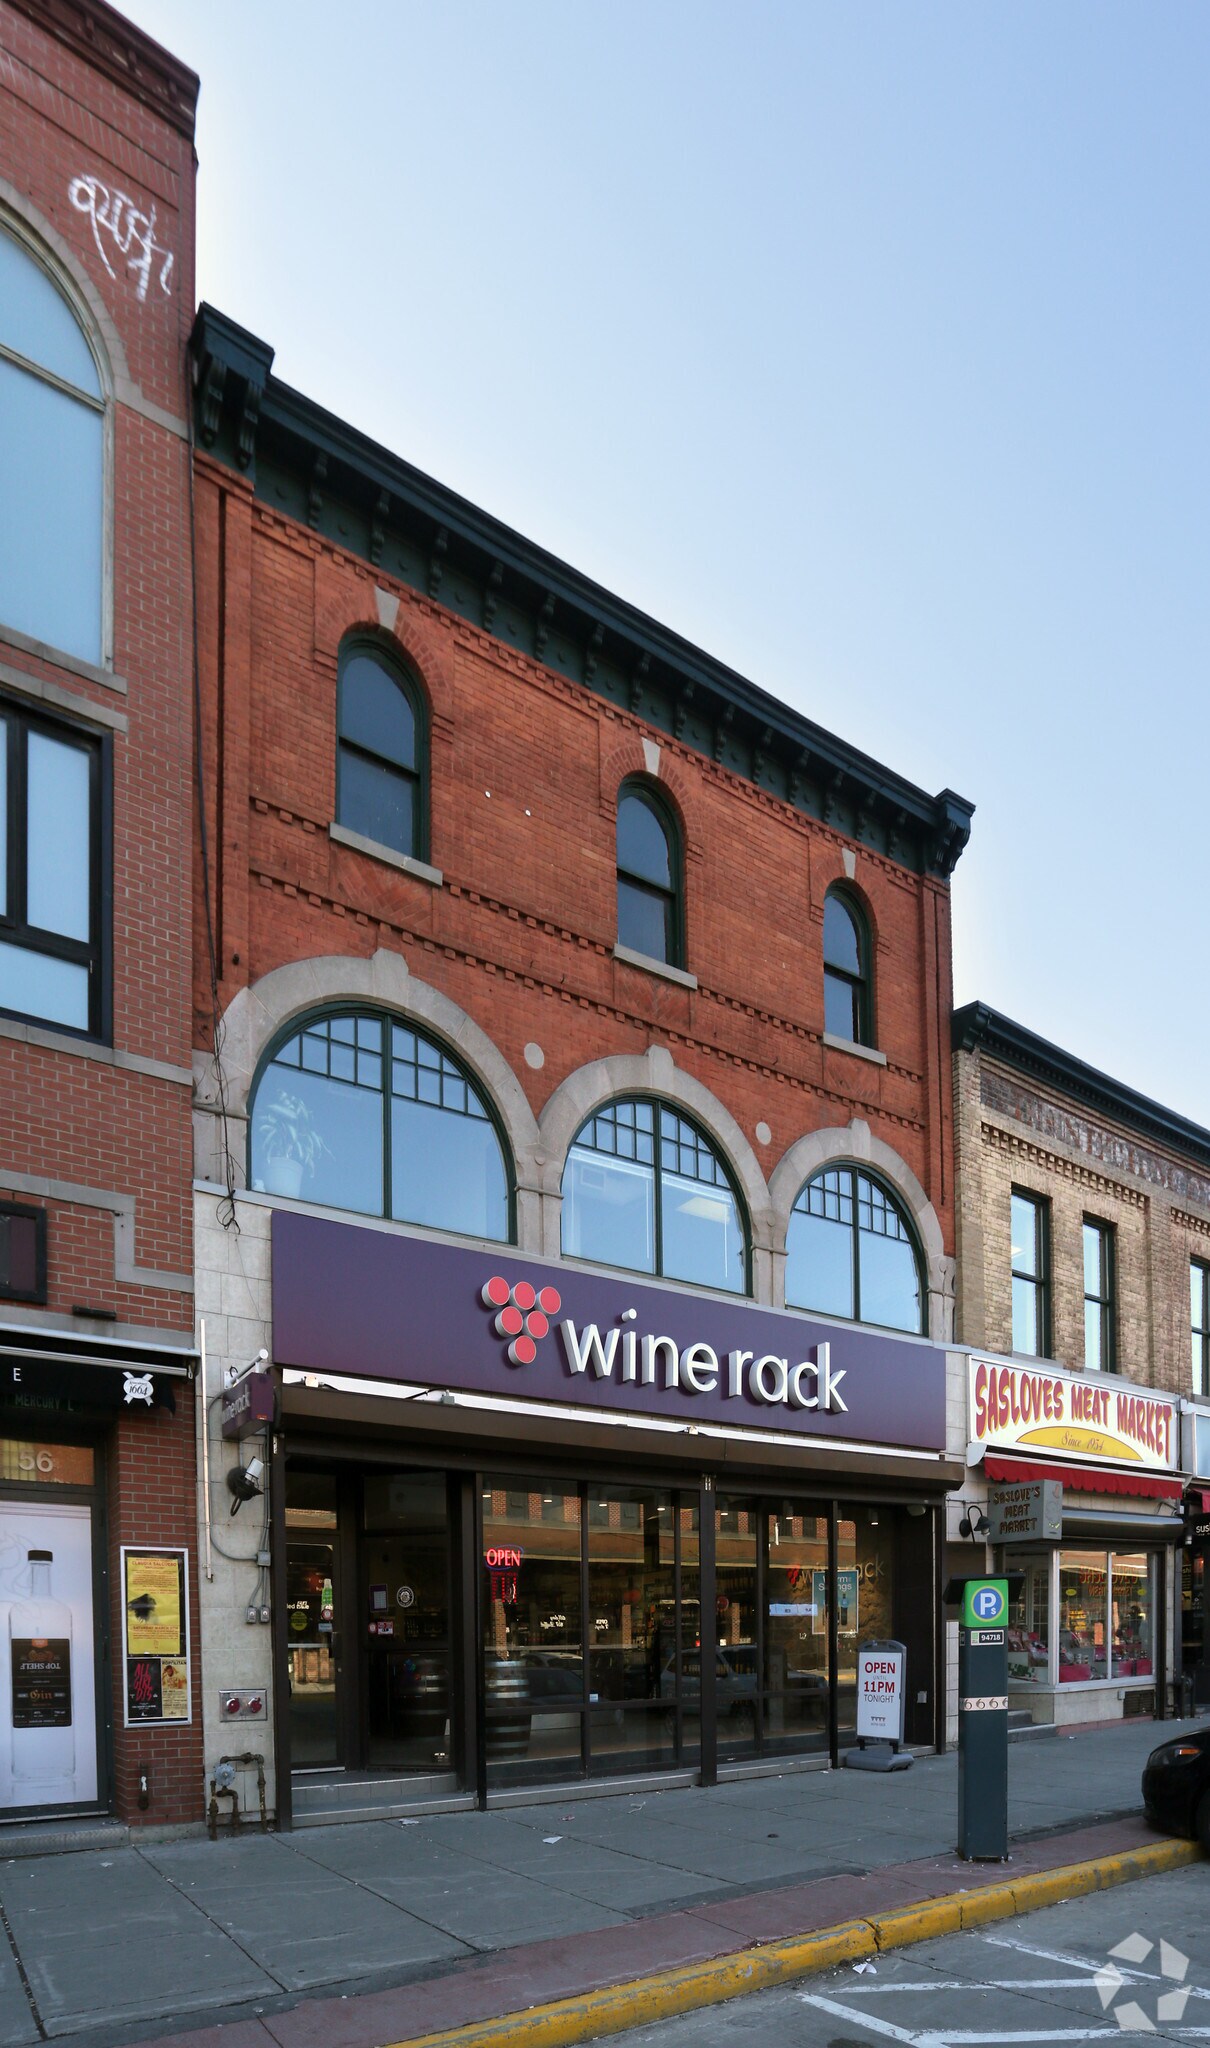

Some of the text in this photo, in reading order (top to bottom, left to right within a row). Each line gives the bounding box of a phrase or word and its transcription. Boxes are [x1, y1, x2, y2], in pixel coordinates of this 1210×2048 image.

[728, 1341, 849, 1414] rack
[129, 1384, 148, 1397] 1664
[14, 1392, 61, 1411] MERCURY
[975, 1363, 1173, 1465] SASLOVES MEAT MARKET
[1060, 1430, 1105, 1452] Since 1954
[18, 1448, 54, 1473] 56
[1004, 1503, 1030, 1519] MEAT
[999, 1517, 1038, 1535] MARKET
[486, 1547, 520, 1567] OPEN
[980, 1633, 1001, 1641] 94718
[864, 1661, 896, 1674] OPEN
[864, 1681, 895, 1693] 11PM
[864, 1694, 894, 1703] TONIGHT
